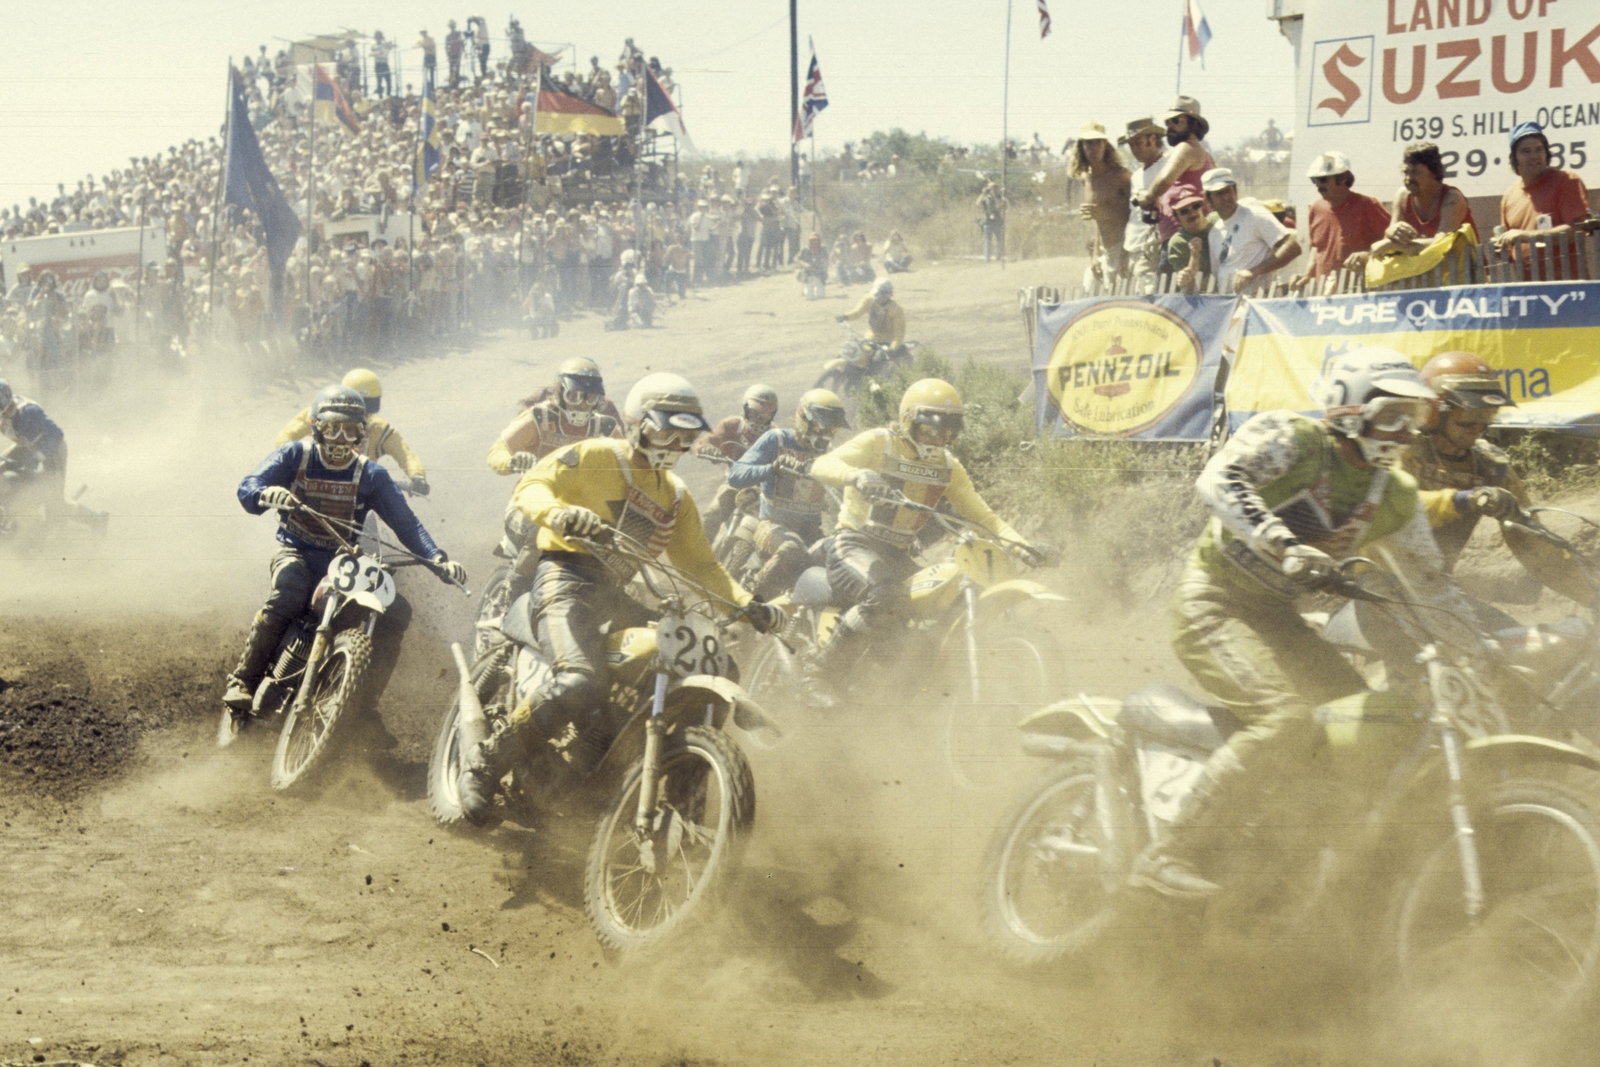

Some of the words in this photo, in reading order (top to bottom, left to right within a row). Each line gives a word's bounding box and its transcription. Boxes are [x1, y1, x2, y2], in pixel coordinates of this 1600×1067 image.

[1386, 0, 1492, 35] LAND
[1392, 116, 1444, 142] 1639
[1451, 114, 1468, 138] S.
[1536, 101, 1600, 131] OCEAN
[1057, 351, 1181, 392] PENNZOIL
[1094, 399, 1154, 422] Lubrication
[674, 625, 719, 676] 28
